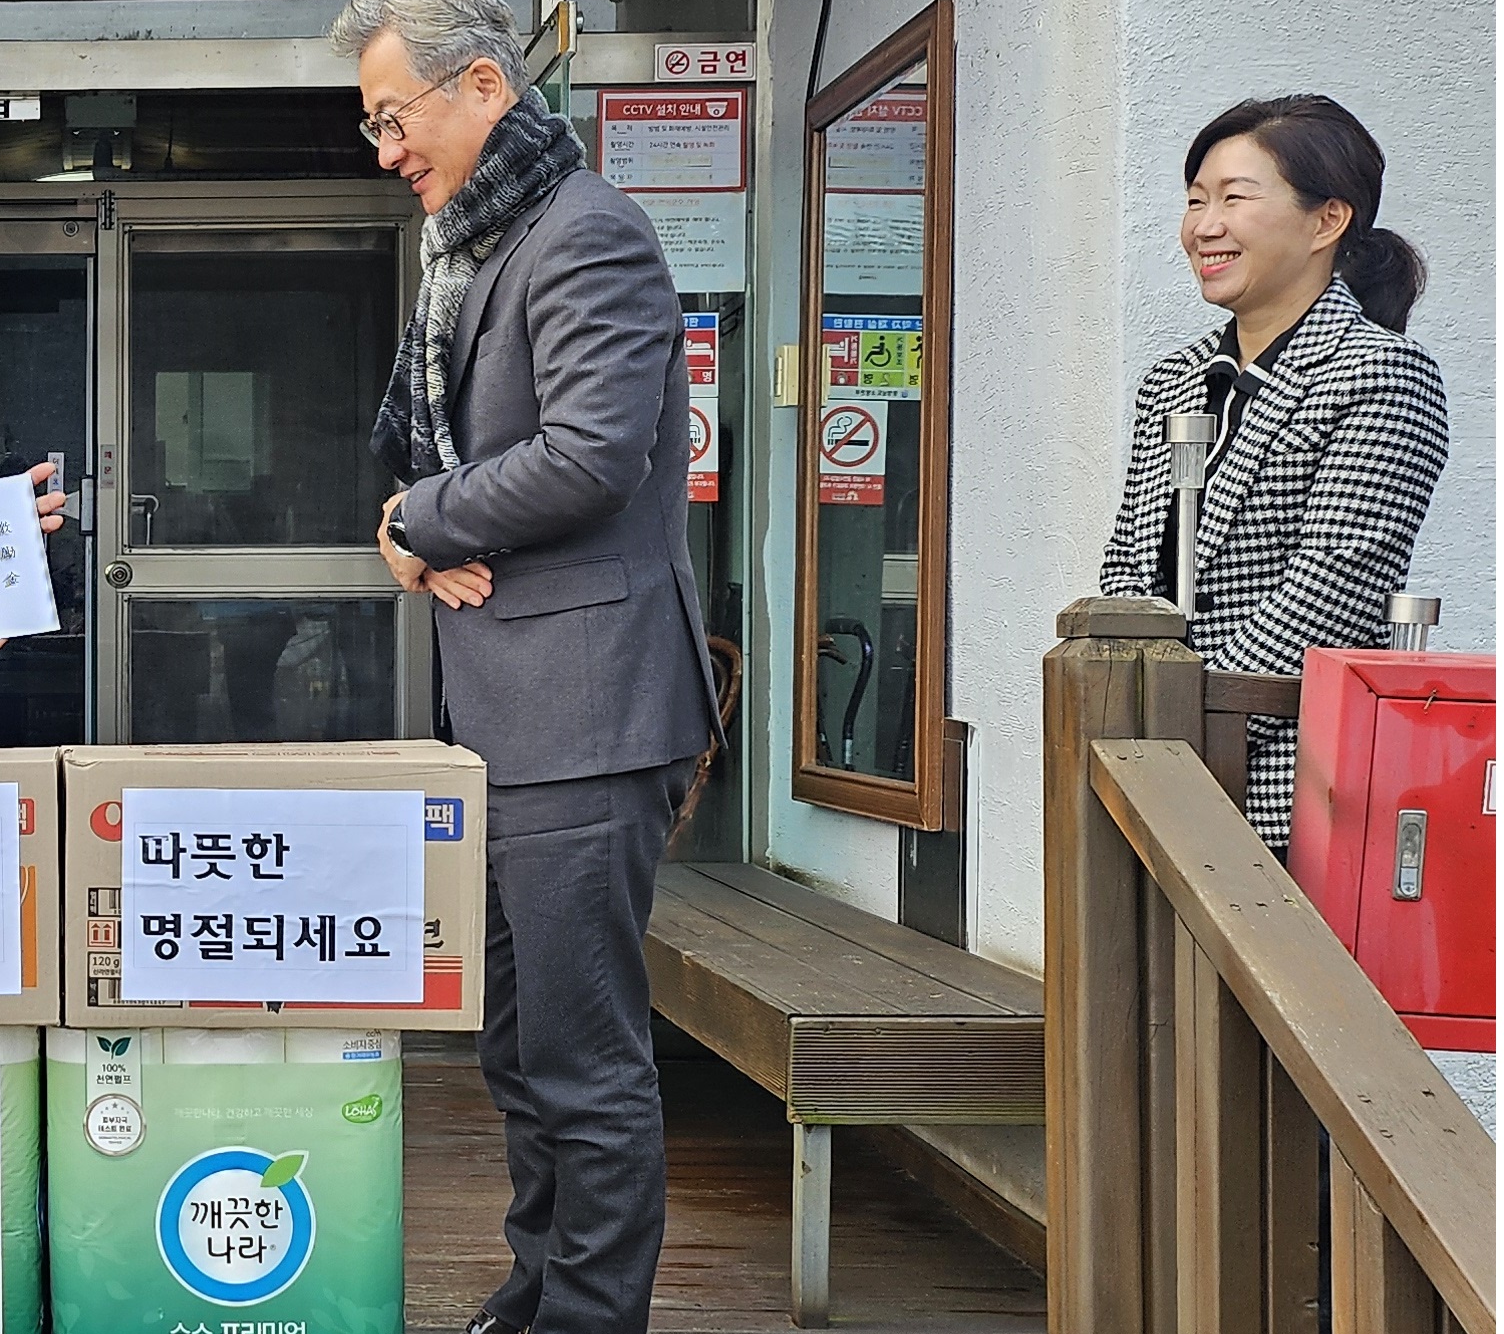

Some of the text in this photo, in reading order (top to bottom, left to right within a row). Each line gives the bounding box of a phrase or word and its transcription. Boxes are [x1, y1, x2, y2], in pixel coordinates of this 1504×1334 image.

[697, 49, 747, 74] 금연
[622, 103, 701, 116] CCTV 설치 안내
[425, 804, 454, 836] 팩
[139, 832, 290, 880] 따뜻한
[139, 913, 391, 962] 명절되세요
[92, 956, 120, 968] 120 g
[102, 1063, 126, 1072] 100%
[345, 1101, 377, 1117] LOHAS
[190, 1198, 283, 1229] 깨끗한
[207, 1235, 267, 1264] 나라
